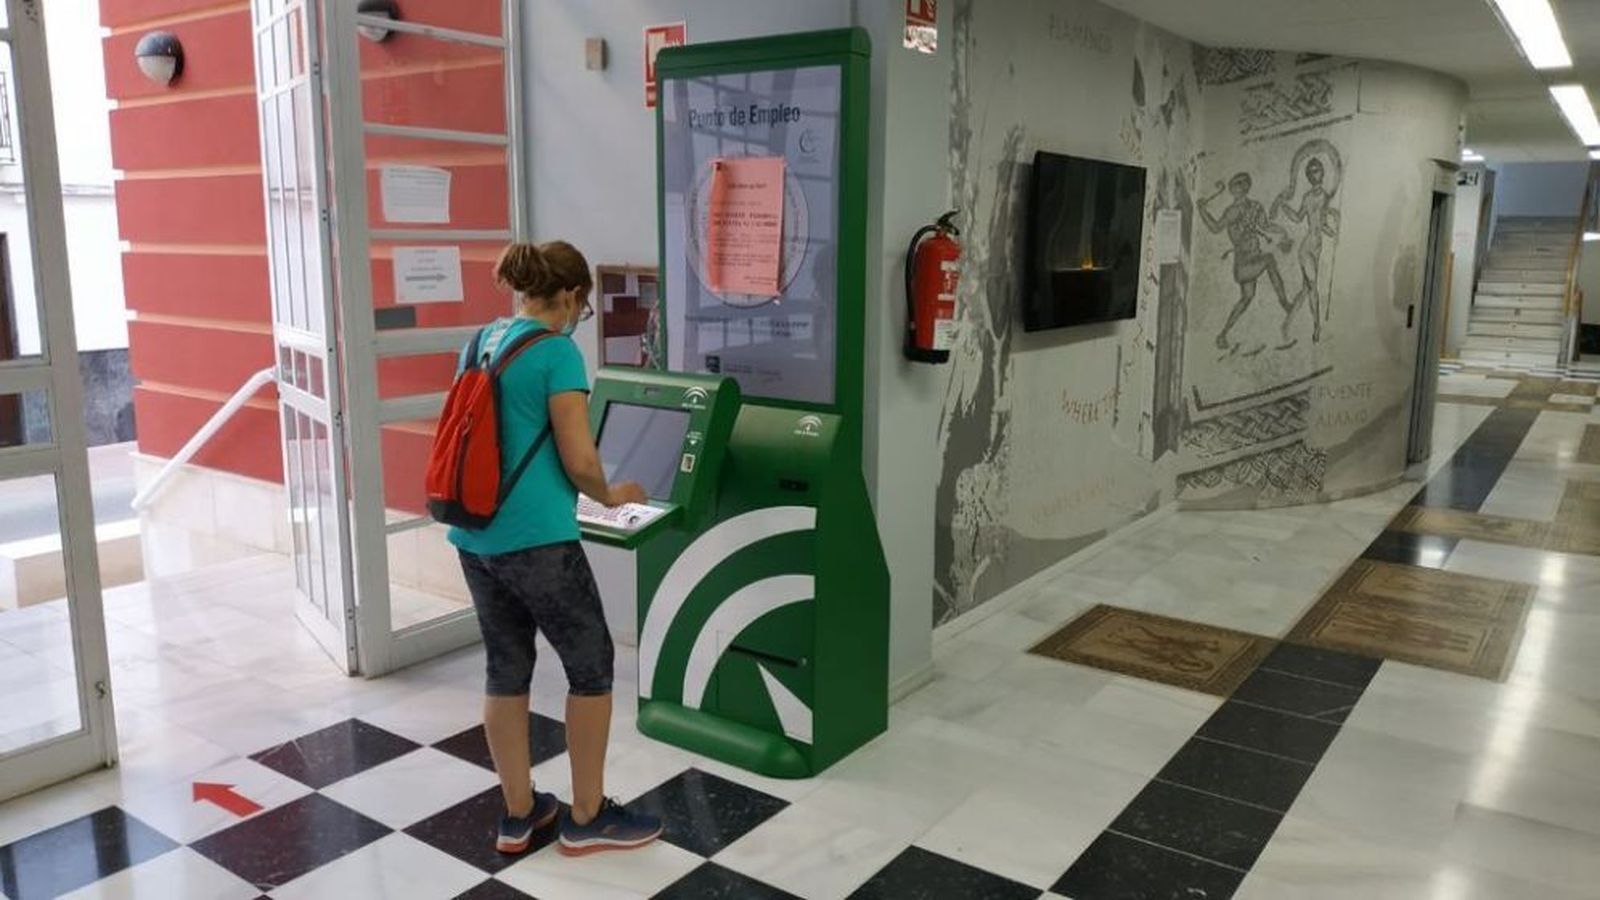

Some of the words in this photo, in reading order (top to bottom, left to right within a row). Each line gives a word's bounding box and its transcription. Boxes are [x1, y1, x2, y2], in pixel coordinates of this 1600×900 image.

[688, 109, 725, 129] Punto
[729, 106, 746, 127] de
[749, 103, 800, 128] Empleo
